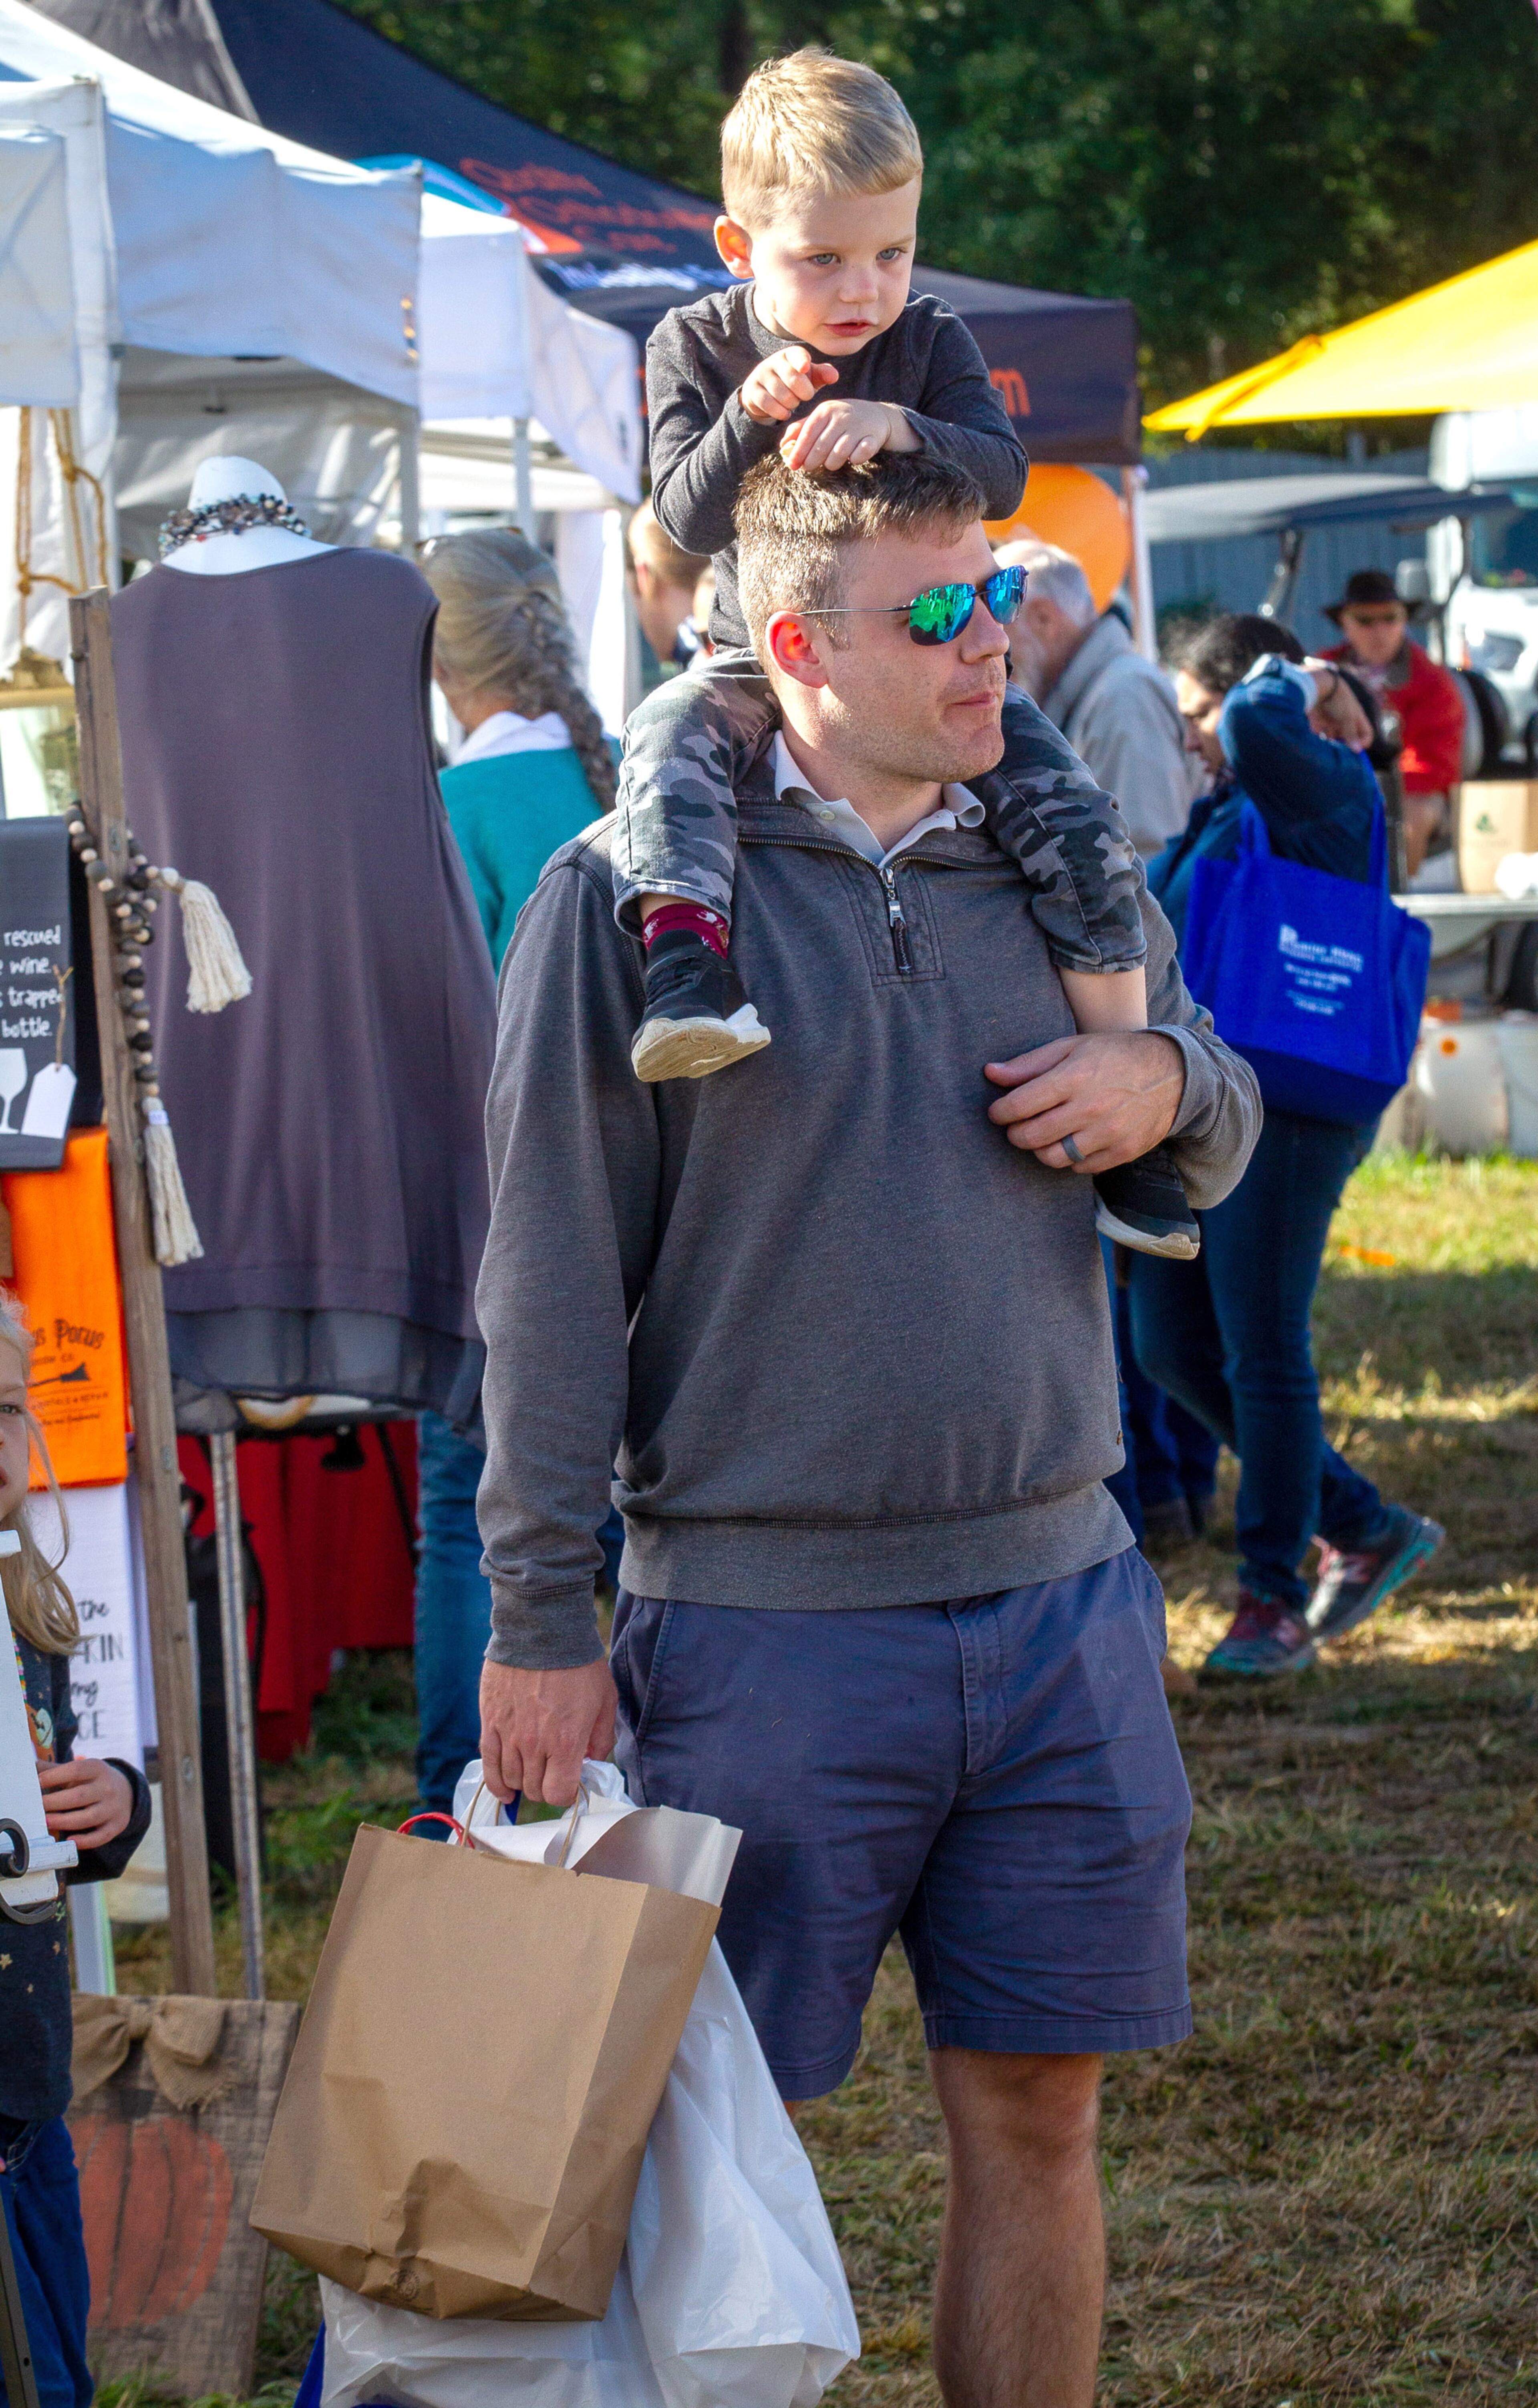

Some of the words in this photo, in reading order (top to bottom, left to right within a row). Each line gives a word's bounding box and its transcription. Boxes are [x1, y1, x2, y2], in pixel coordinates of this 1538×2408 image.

[4, 925, 61, 947] rescued
[10, 956, 51, 975] wine.
[2, 1016, 53, 1038] bottle.
